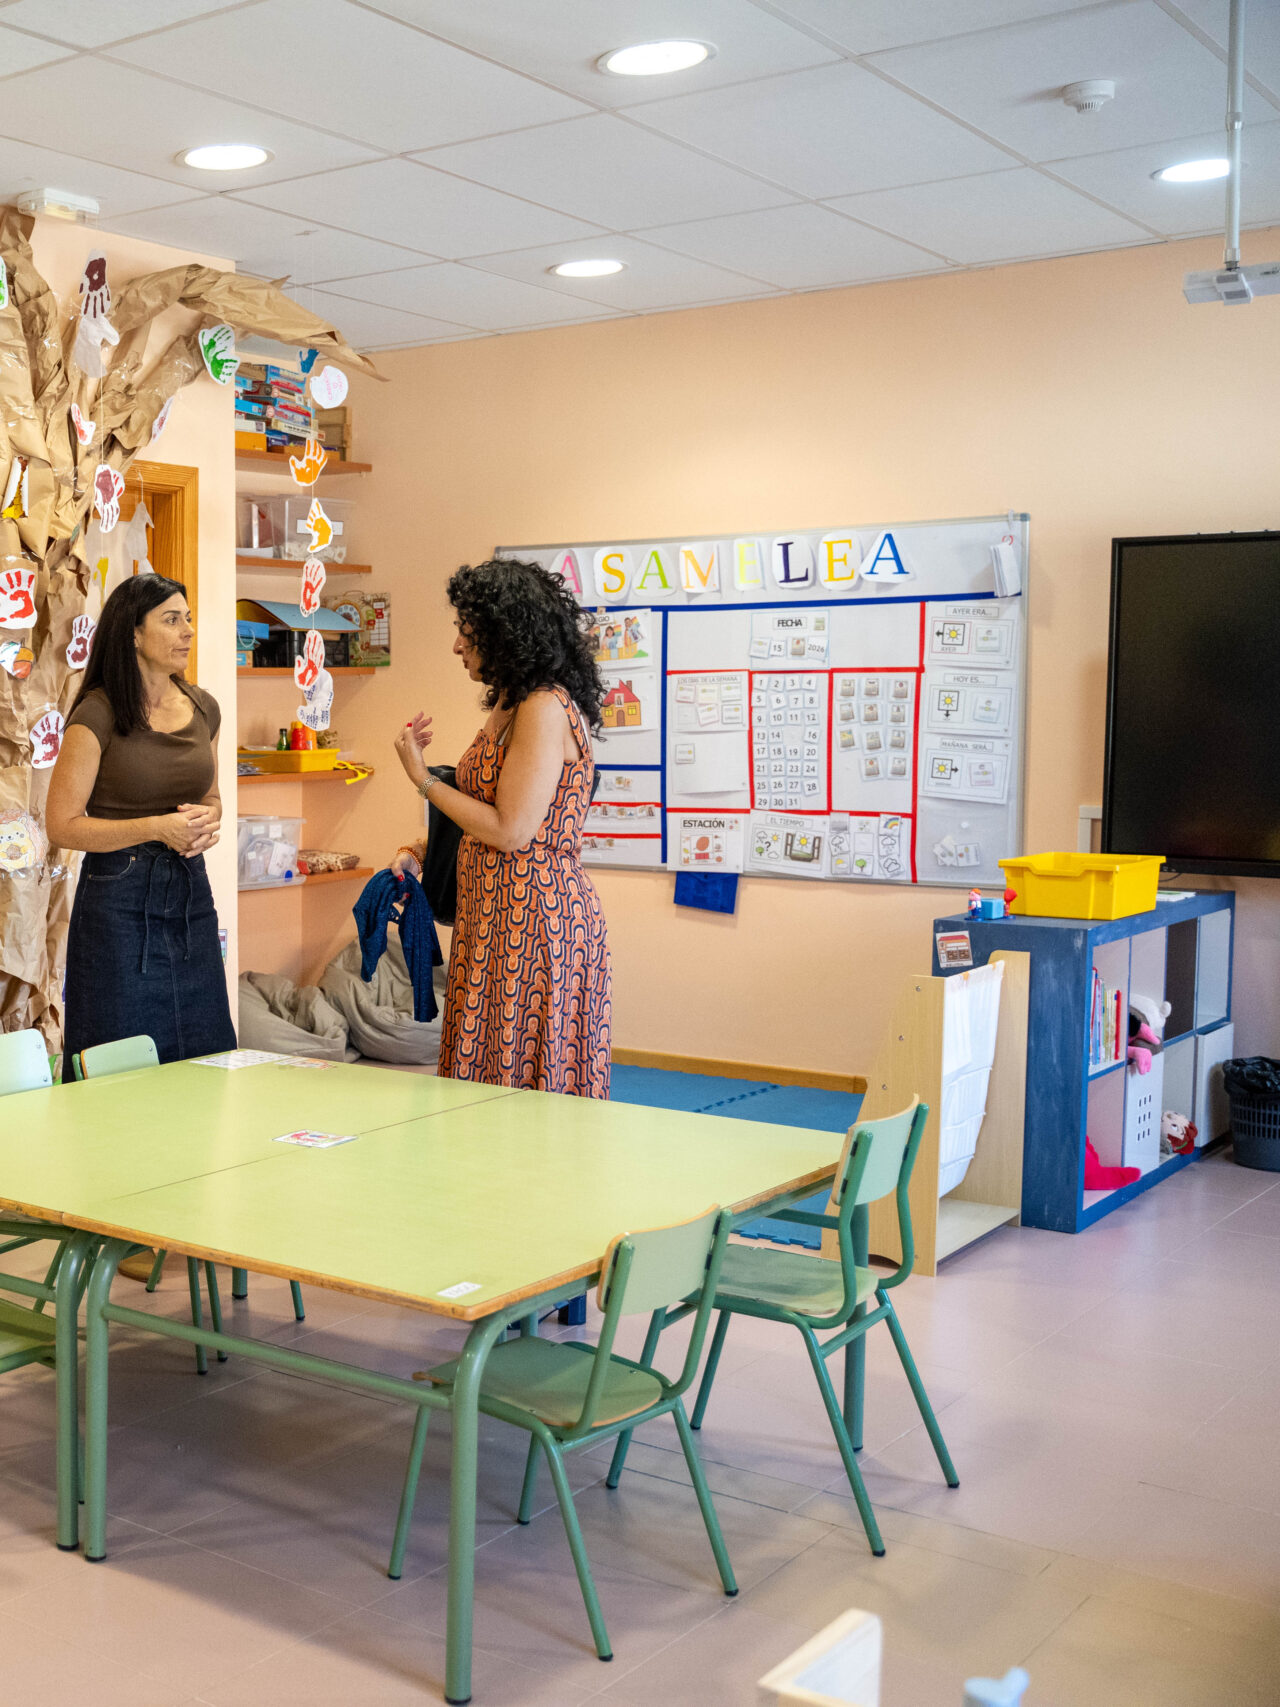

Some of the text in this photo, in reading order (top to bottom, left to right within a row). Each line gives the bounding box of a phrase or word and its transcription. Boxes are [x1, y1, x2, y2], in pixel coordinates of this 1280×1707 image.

[777, 618, 803, 628] FECHA
[807, 783, 816, 791] 28
[683, 818, 725, 828] ESTACIÓN
[780, 818, 805, 827] TIEMPO
